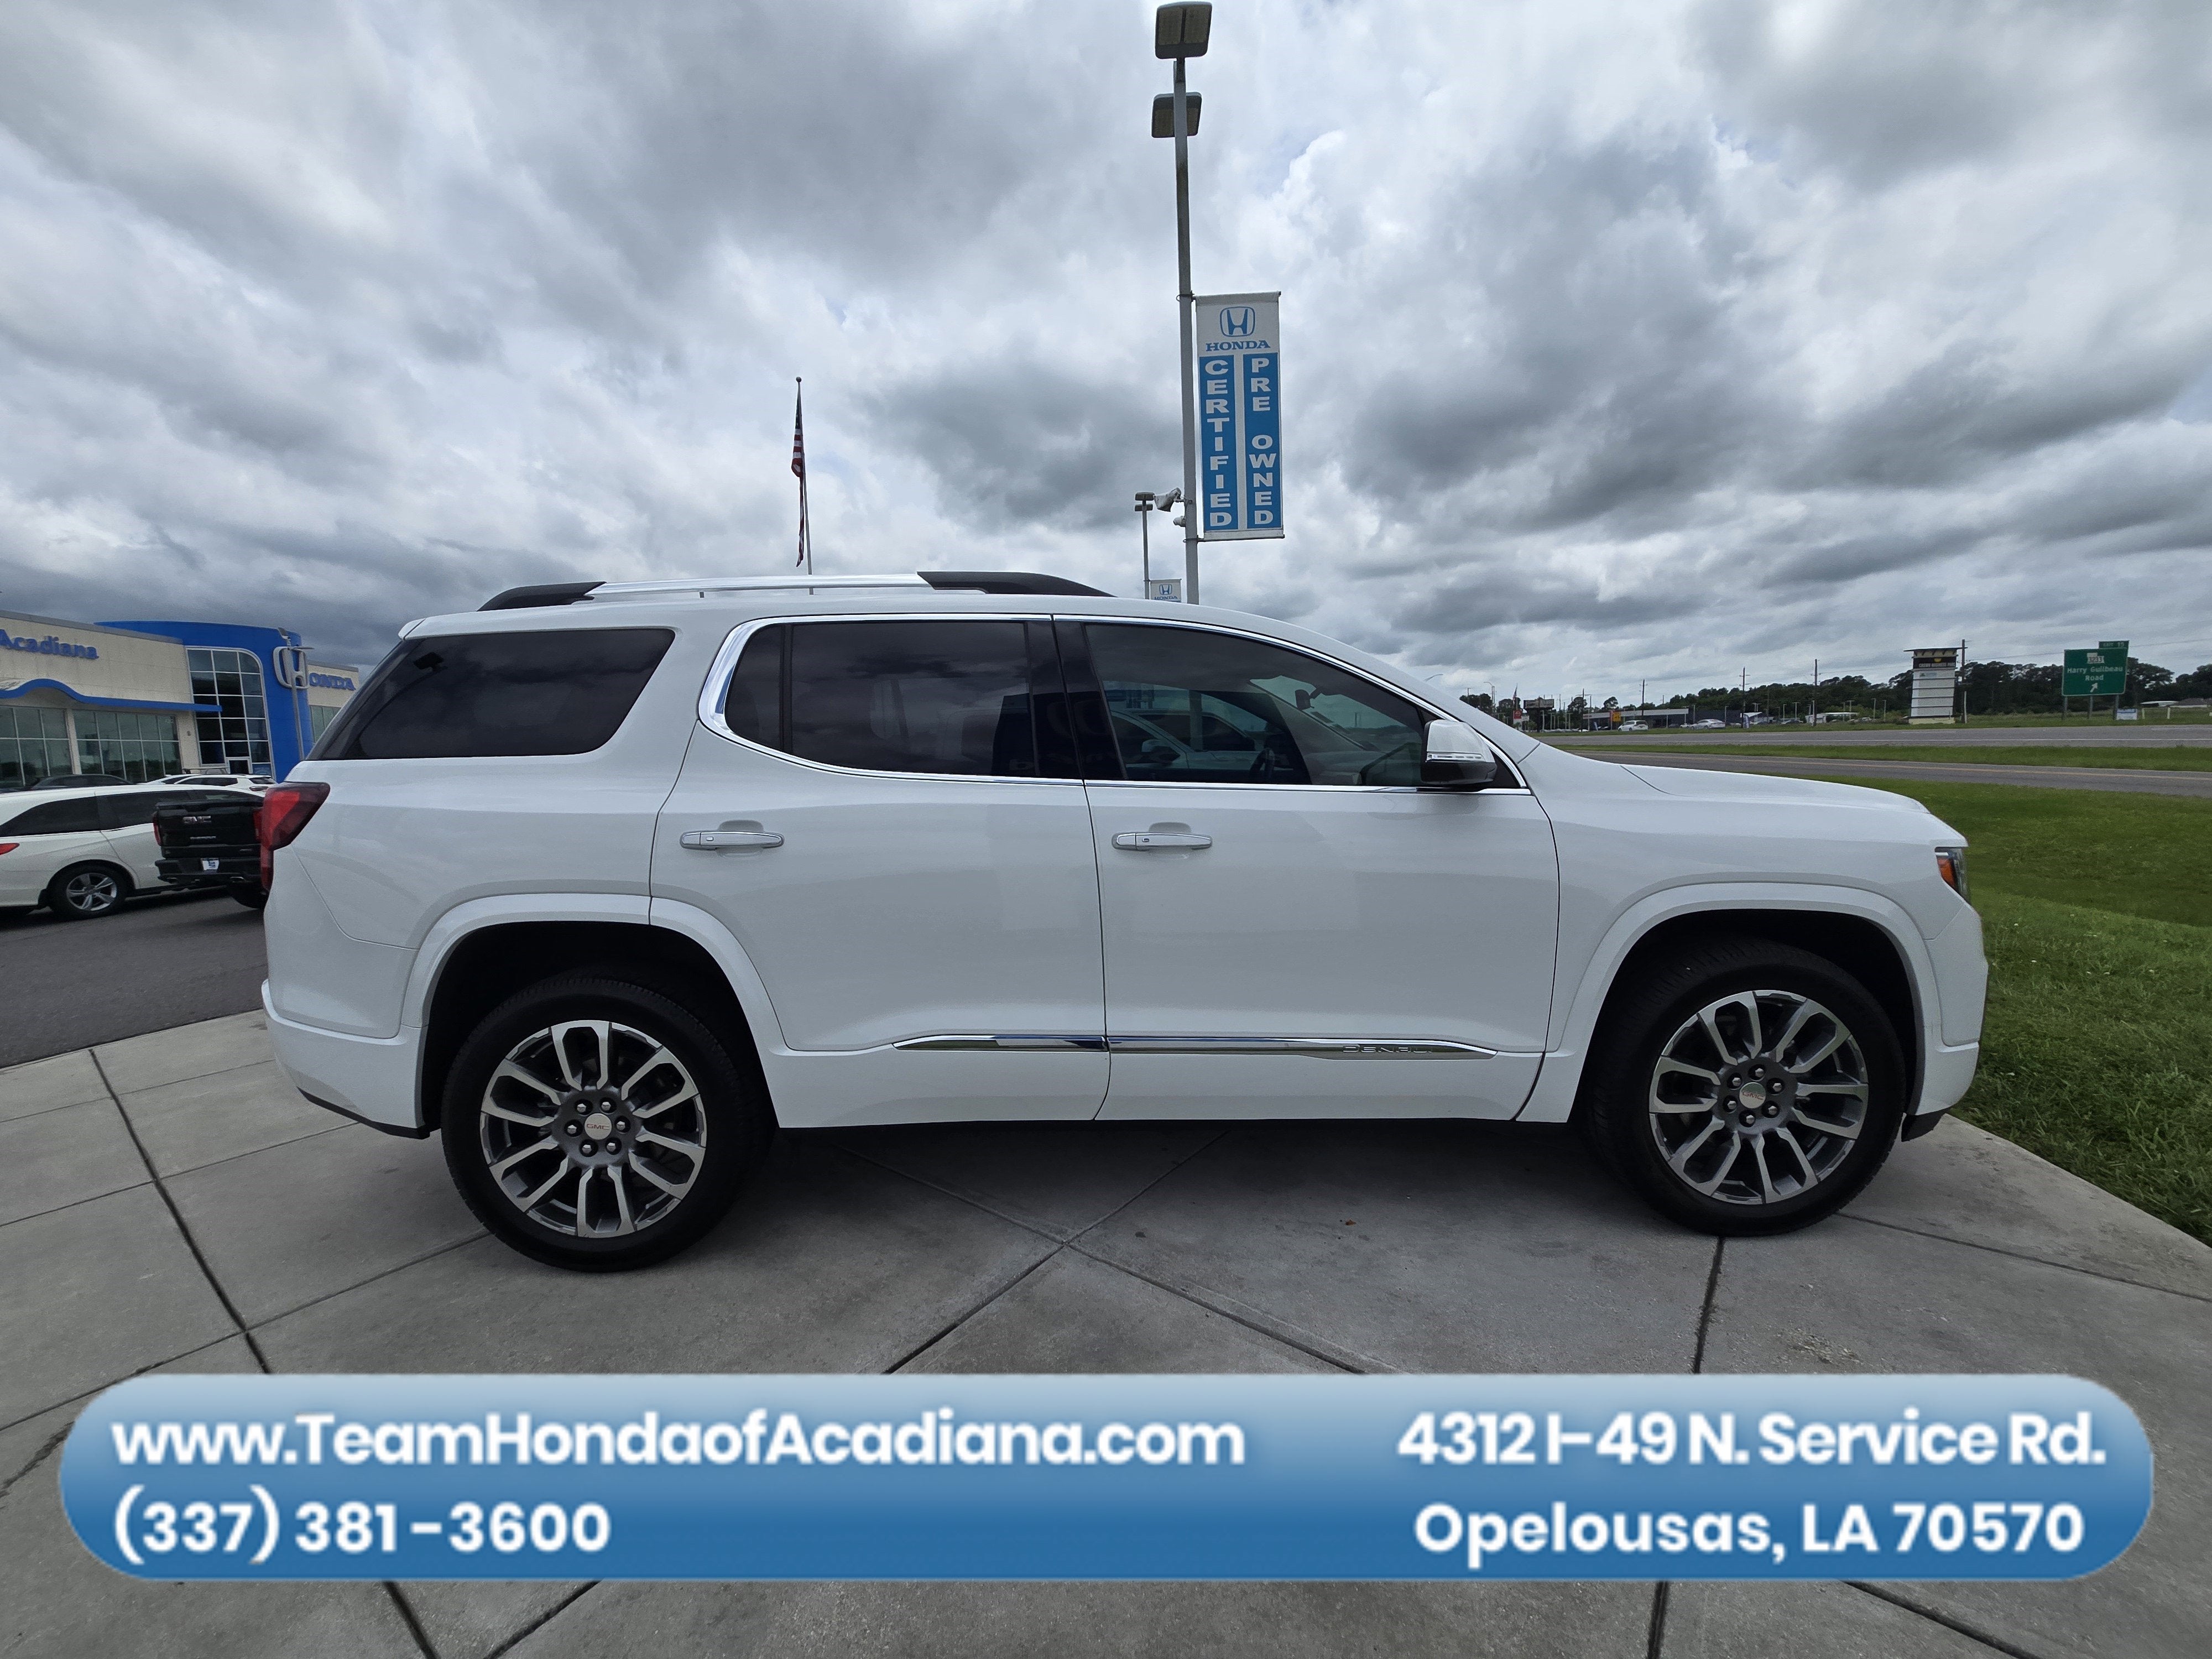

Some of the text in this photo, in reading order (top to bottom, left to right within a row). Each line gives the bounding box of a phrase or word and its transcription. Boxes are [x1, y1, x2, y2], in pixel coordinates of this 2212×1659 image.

[1206, 340, 1271, 352] HONDA
[1204, 359, 1232, 527] CERTIFIED
[1249, 357, 1277, 525] PRE OWNED
[309, 672, 357, 691] ONDA
[1742, 1090, 1764, 1100] GMC
